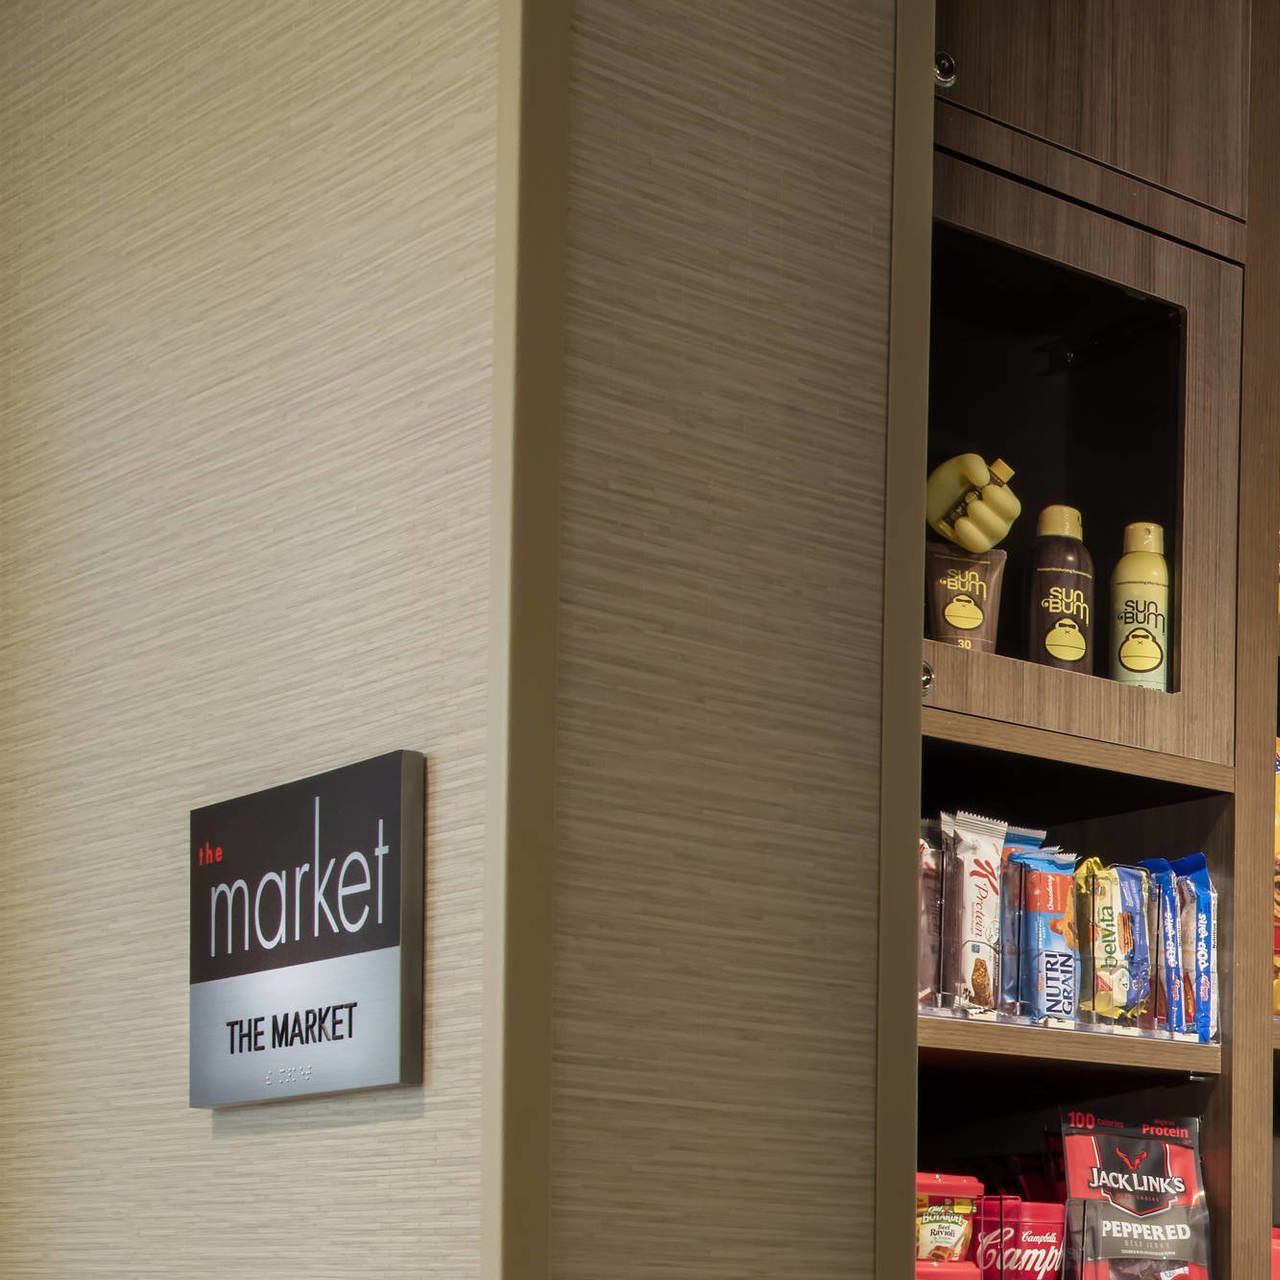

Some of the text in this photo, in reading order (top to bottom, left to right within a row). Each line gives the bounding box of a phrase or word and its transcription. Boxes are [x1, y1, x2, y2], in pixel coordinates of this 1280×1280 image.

[957, 639, 972, 649] 30
[199, 841, 223, 865] the
[210, 796, 389, 957] market
[972, 883, 989, 938] Protein
[1045, 953, 1062, 1014] NUTRI
[1059, 953, 1074, 1016] GRAIN
[226, 1002, 357, 1055] THE MARKET
[1068, 1112, 1096, 1129] 100
[1142, 1124, 1189, 1139] Protein
[1089, 1168, 1186, 1195] JACK LINK'S
[1102, 1220, 1191, 1241] PEPPERED
